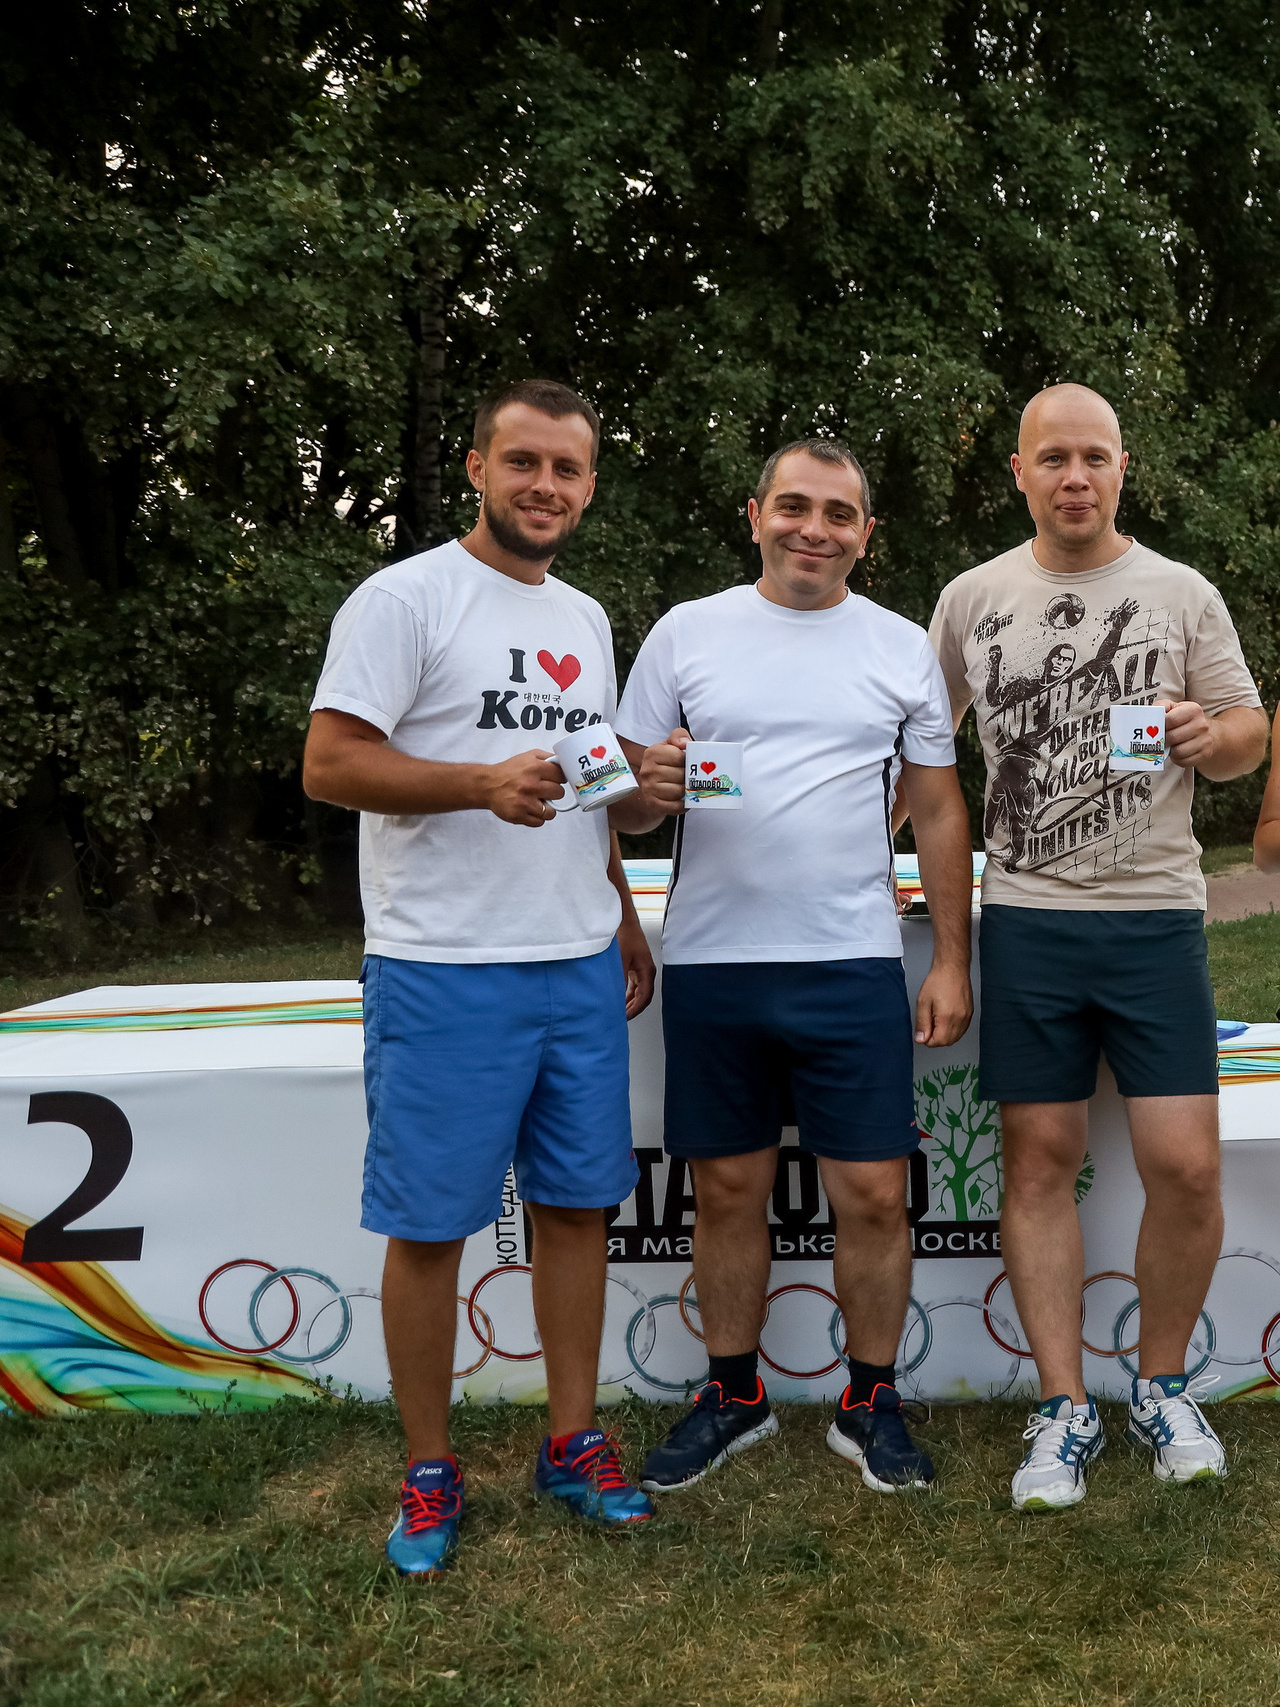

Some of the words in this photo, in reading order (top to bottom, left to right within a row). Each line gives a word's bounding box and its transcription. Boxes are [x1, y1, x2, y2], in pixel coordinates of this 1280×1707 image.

[508, 648, 528, 684] I
[1090, 647, 1162, 710] ALL
[523, 692, 562, 705] 대한민국
[1078, 734, 1108, 762] BUT
[1132, 728, 1144, 740] Я
[577, 754, 591, 770] Я
[689, 763, 698, 776] Я
[1112, 774, 1154, 825] US
[1026, 808, 1111, 866] UNITES
[21, 1090, 145, 1263] 2
